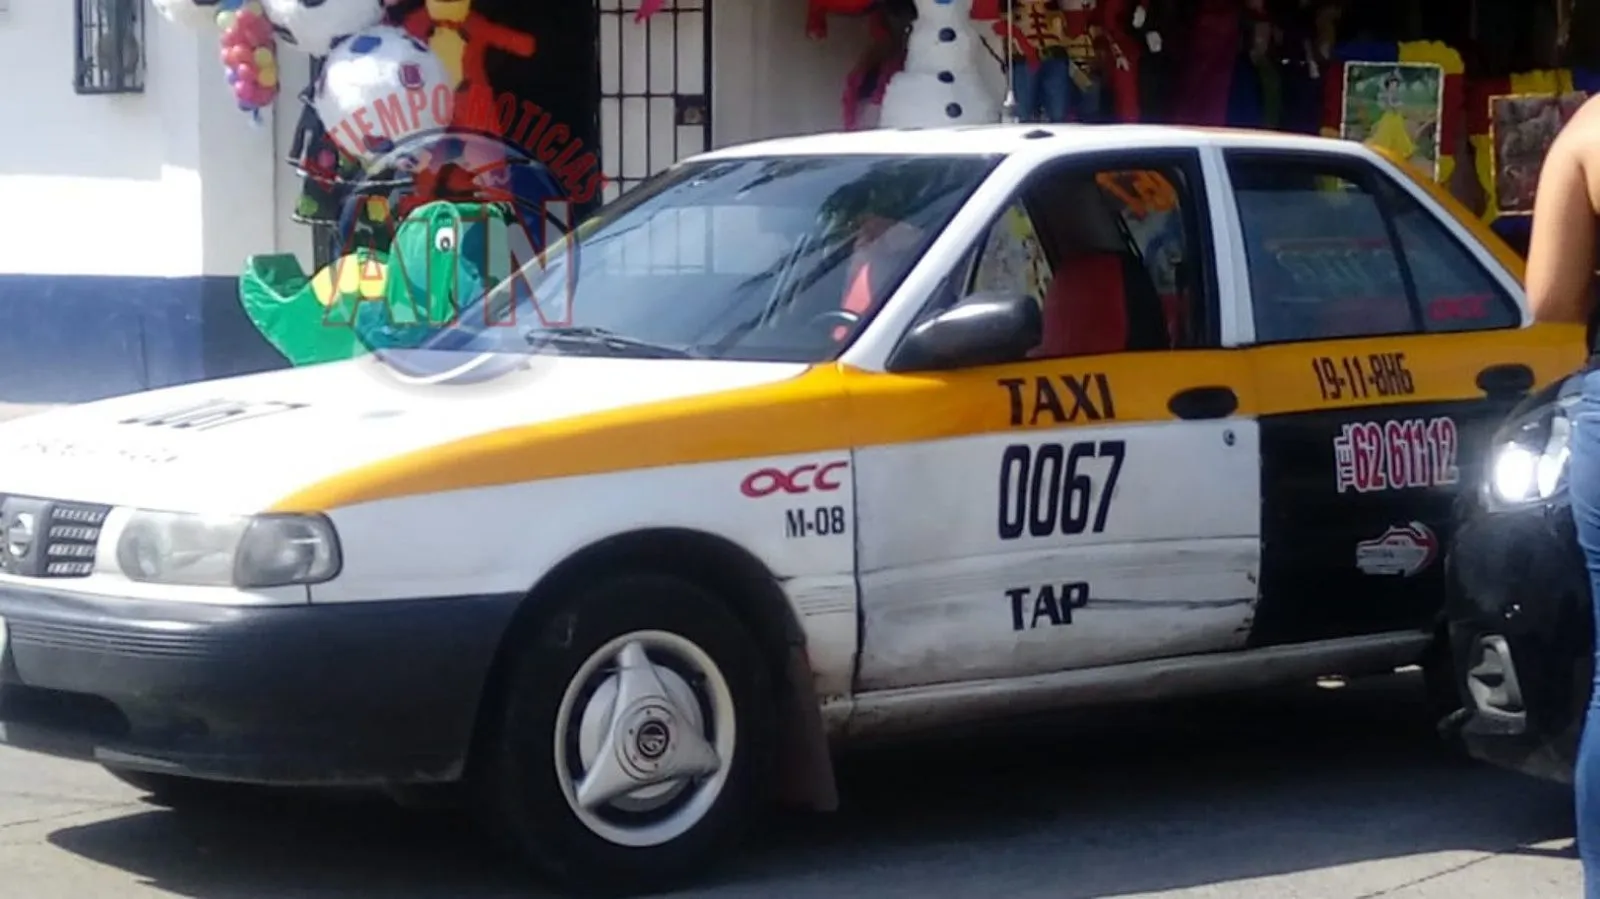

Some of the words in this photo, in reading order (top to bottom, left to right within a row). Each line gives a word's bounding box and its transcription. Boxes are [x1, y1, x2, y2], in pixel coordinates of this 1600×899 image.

[997, 373, 1116, 426] TAXI
[740, 460, 848, 497] OCC
[998, 440, 1126, 540] 0067
[785, 505, 846, 538] M-08
[1005, 581, 1090, 631] TAP
